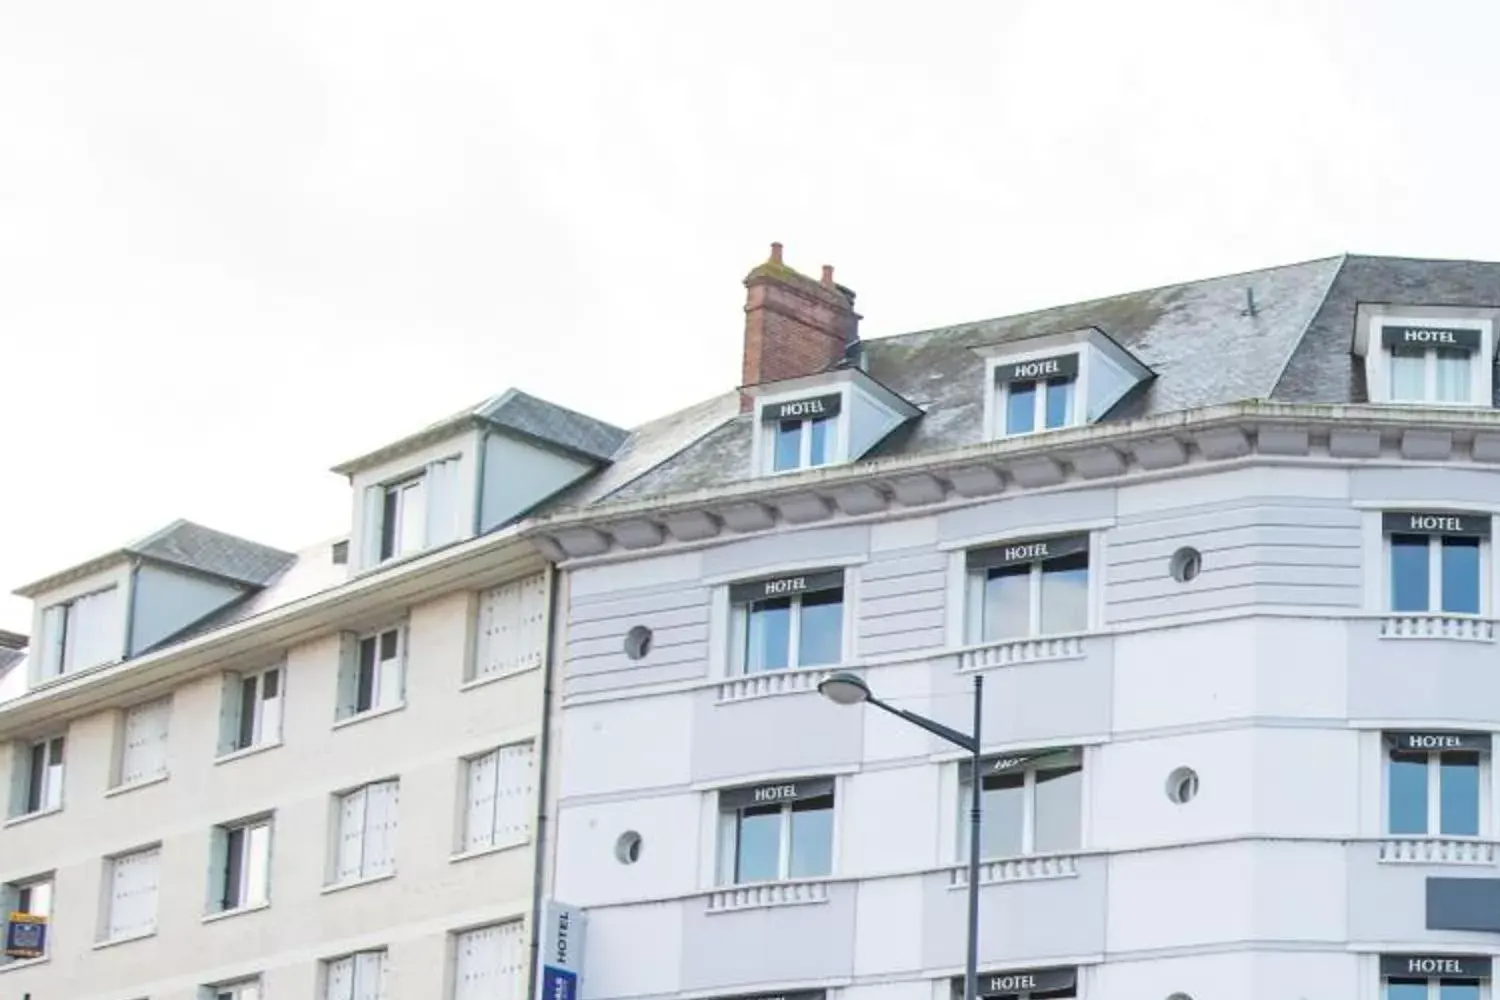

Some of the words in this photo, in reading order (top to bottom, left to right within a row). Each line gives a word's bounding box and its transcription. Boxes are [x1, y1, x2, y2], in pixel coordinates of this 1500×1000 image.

[1405, 330, 1456, 343] HOTEL
[1015, 360, 1060, 377] HOTEL
[781, 400, 826, 416] HOTEL
[1411, 516, 1463, 531] HOTEL
[1005, 544, 1048, 561] HOTEL
[765, 578, 807, 594] HOTEL
[1409, 735, 1462, 747] HOTEL
[755, 785, 797, 801] HOTEL
[557, 912, 569, 964] HOTEL
[1409, 959, 1462, 973] HOTEL
[991, 975, 1036, 991] HOTEL
